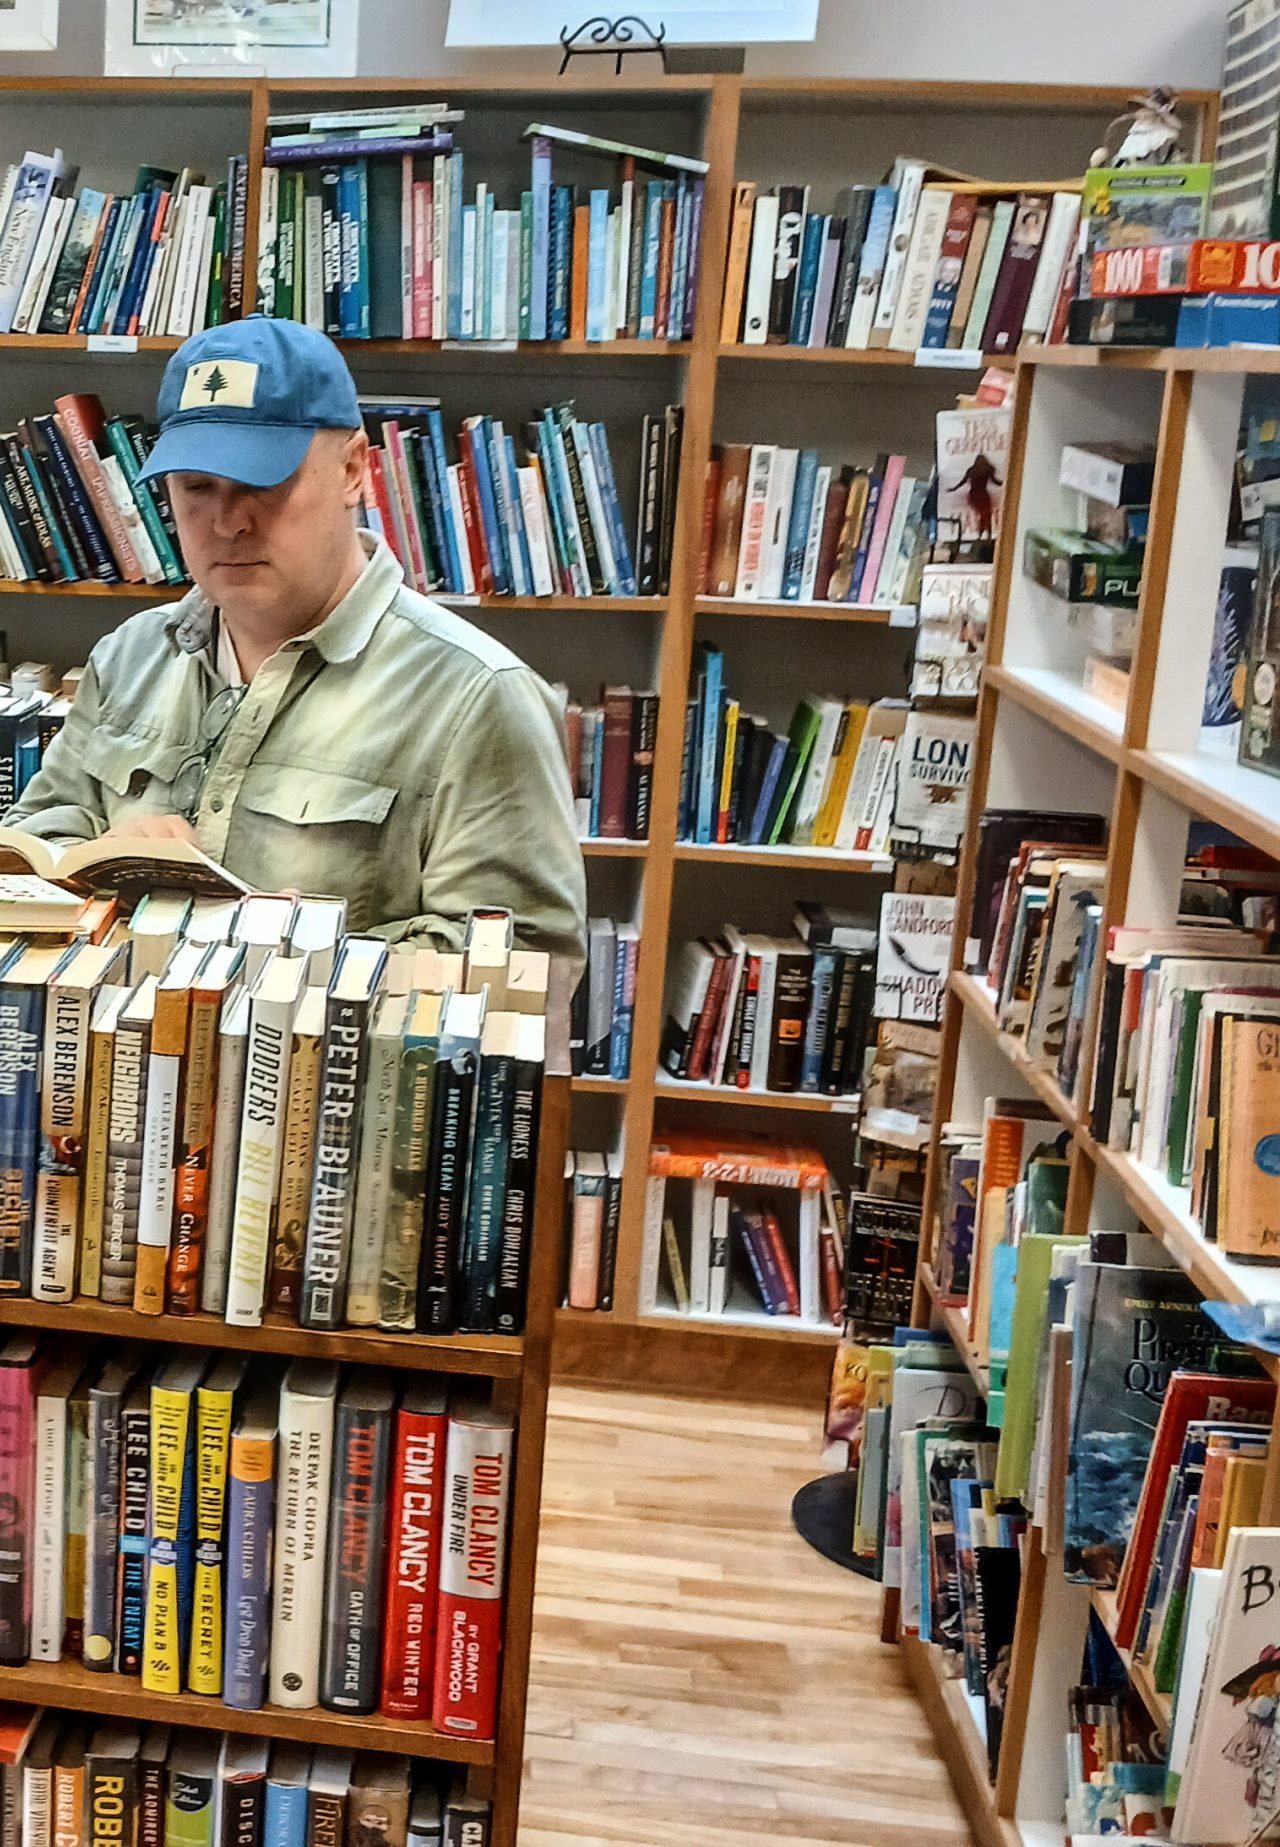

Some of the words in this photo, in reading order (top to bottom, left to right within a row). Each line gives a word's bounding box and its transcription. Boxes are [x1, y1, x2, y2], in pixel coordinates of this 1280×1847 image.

[10, 208, 28, 235] New
[232, 164, 248, 241] EXPLORE
[229, 241, 244, 308] AMERICA
[92, 477, 136, 572] IMPRESSIONISTS
[887, 899, 924, 920] JOHN
[54, 995, 81, 1037] ALEX
[17, 1031, 39, 1072] ALEX
[247, 1022, 283, 1126] DODGERS
[322, 1024, 360, 1119] PETER
[52, 1040, 80, 1127] BERENSON
[111, 1029, 143, 1143] NEIGHBORS
[514, 1090, 533, 1111] THE
[442, 1088, 460, 1150] BREAKING
[511, 1113, 531, 1160] LIONESS
[182, 1154, 202, 1202] NEVER
[439, 1154, 458, 1192] CLEAN
[309, 1145, 351, 1284] BLAUNER
[435, 1196, 451, 1231] JUDY
[505, 1189, 525, 1222] CHRIS
[176, 1213, 195, 1273] CHANGE
[433, 1235, 449, 1276] BLUNT
[501, 1225, 523, 1288] BOHJALIAN
[125, 1419, 150, 1456] LEE
[157, 1424, 180, 1453] LEE
[200, 1425, 224, 1452] LEE
[288, 1430, 303, 1462] THE
[304, 1431, 322, 1491] DEEPAK
[347, 1424, 376, 1478] TOM
[404, 1432, 435, 1486] TOM
[125, 1466, 148, 1530] CHILD
[284, 1467, 301, 1532] RETURN
[451, 1473, 469, 1522] UNDER
[472, 1452, 503, 1498] TOM
[155, 1485, 179, 1531] CHILD
[199, 1486, 222, 1533] CHILD
[302, 1496, 319, 1561] CHOPRA
[339, 1480, 372, 1583] CLANCY
[284, 1537, 298, 1557] OF
[397, 1491, 432, 1593] CLANCY
[449, 1525, 466, 1556] FIRE
[467, 1504, 498, 1586] CLANCY
[125, 1561, 144, 1591] THE
[280, 1561, 297, 1622] MERLIN
[123, 1596, 142, 1650] ENEMY
[348, 1591, 363, 1626] OATH
[408, 1602, 423, 1633] RED
[348, 1628, 361, 1641] OF
[449, 1610, 466, 1703] BLACKWOOD
[344, 1643, 362, 1692] OFFICE
[404, 1639, 421, 1697] WINTER
[56, 1774, 76, 1828] ROBERT
